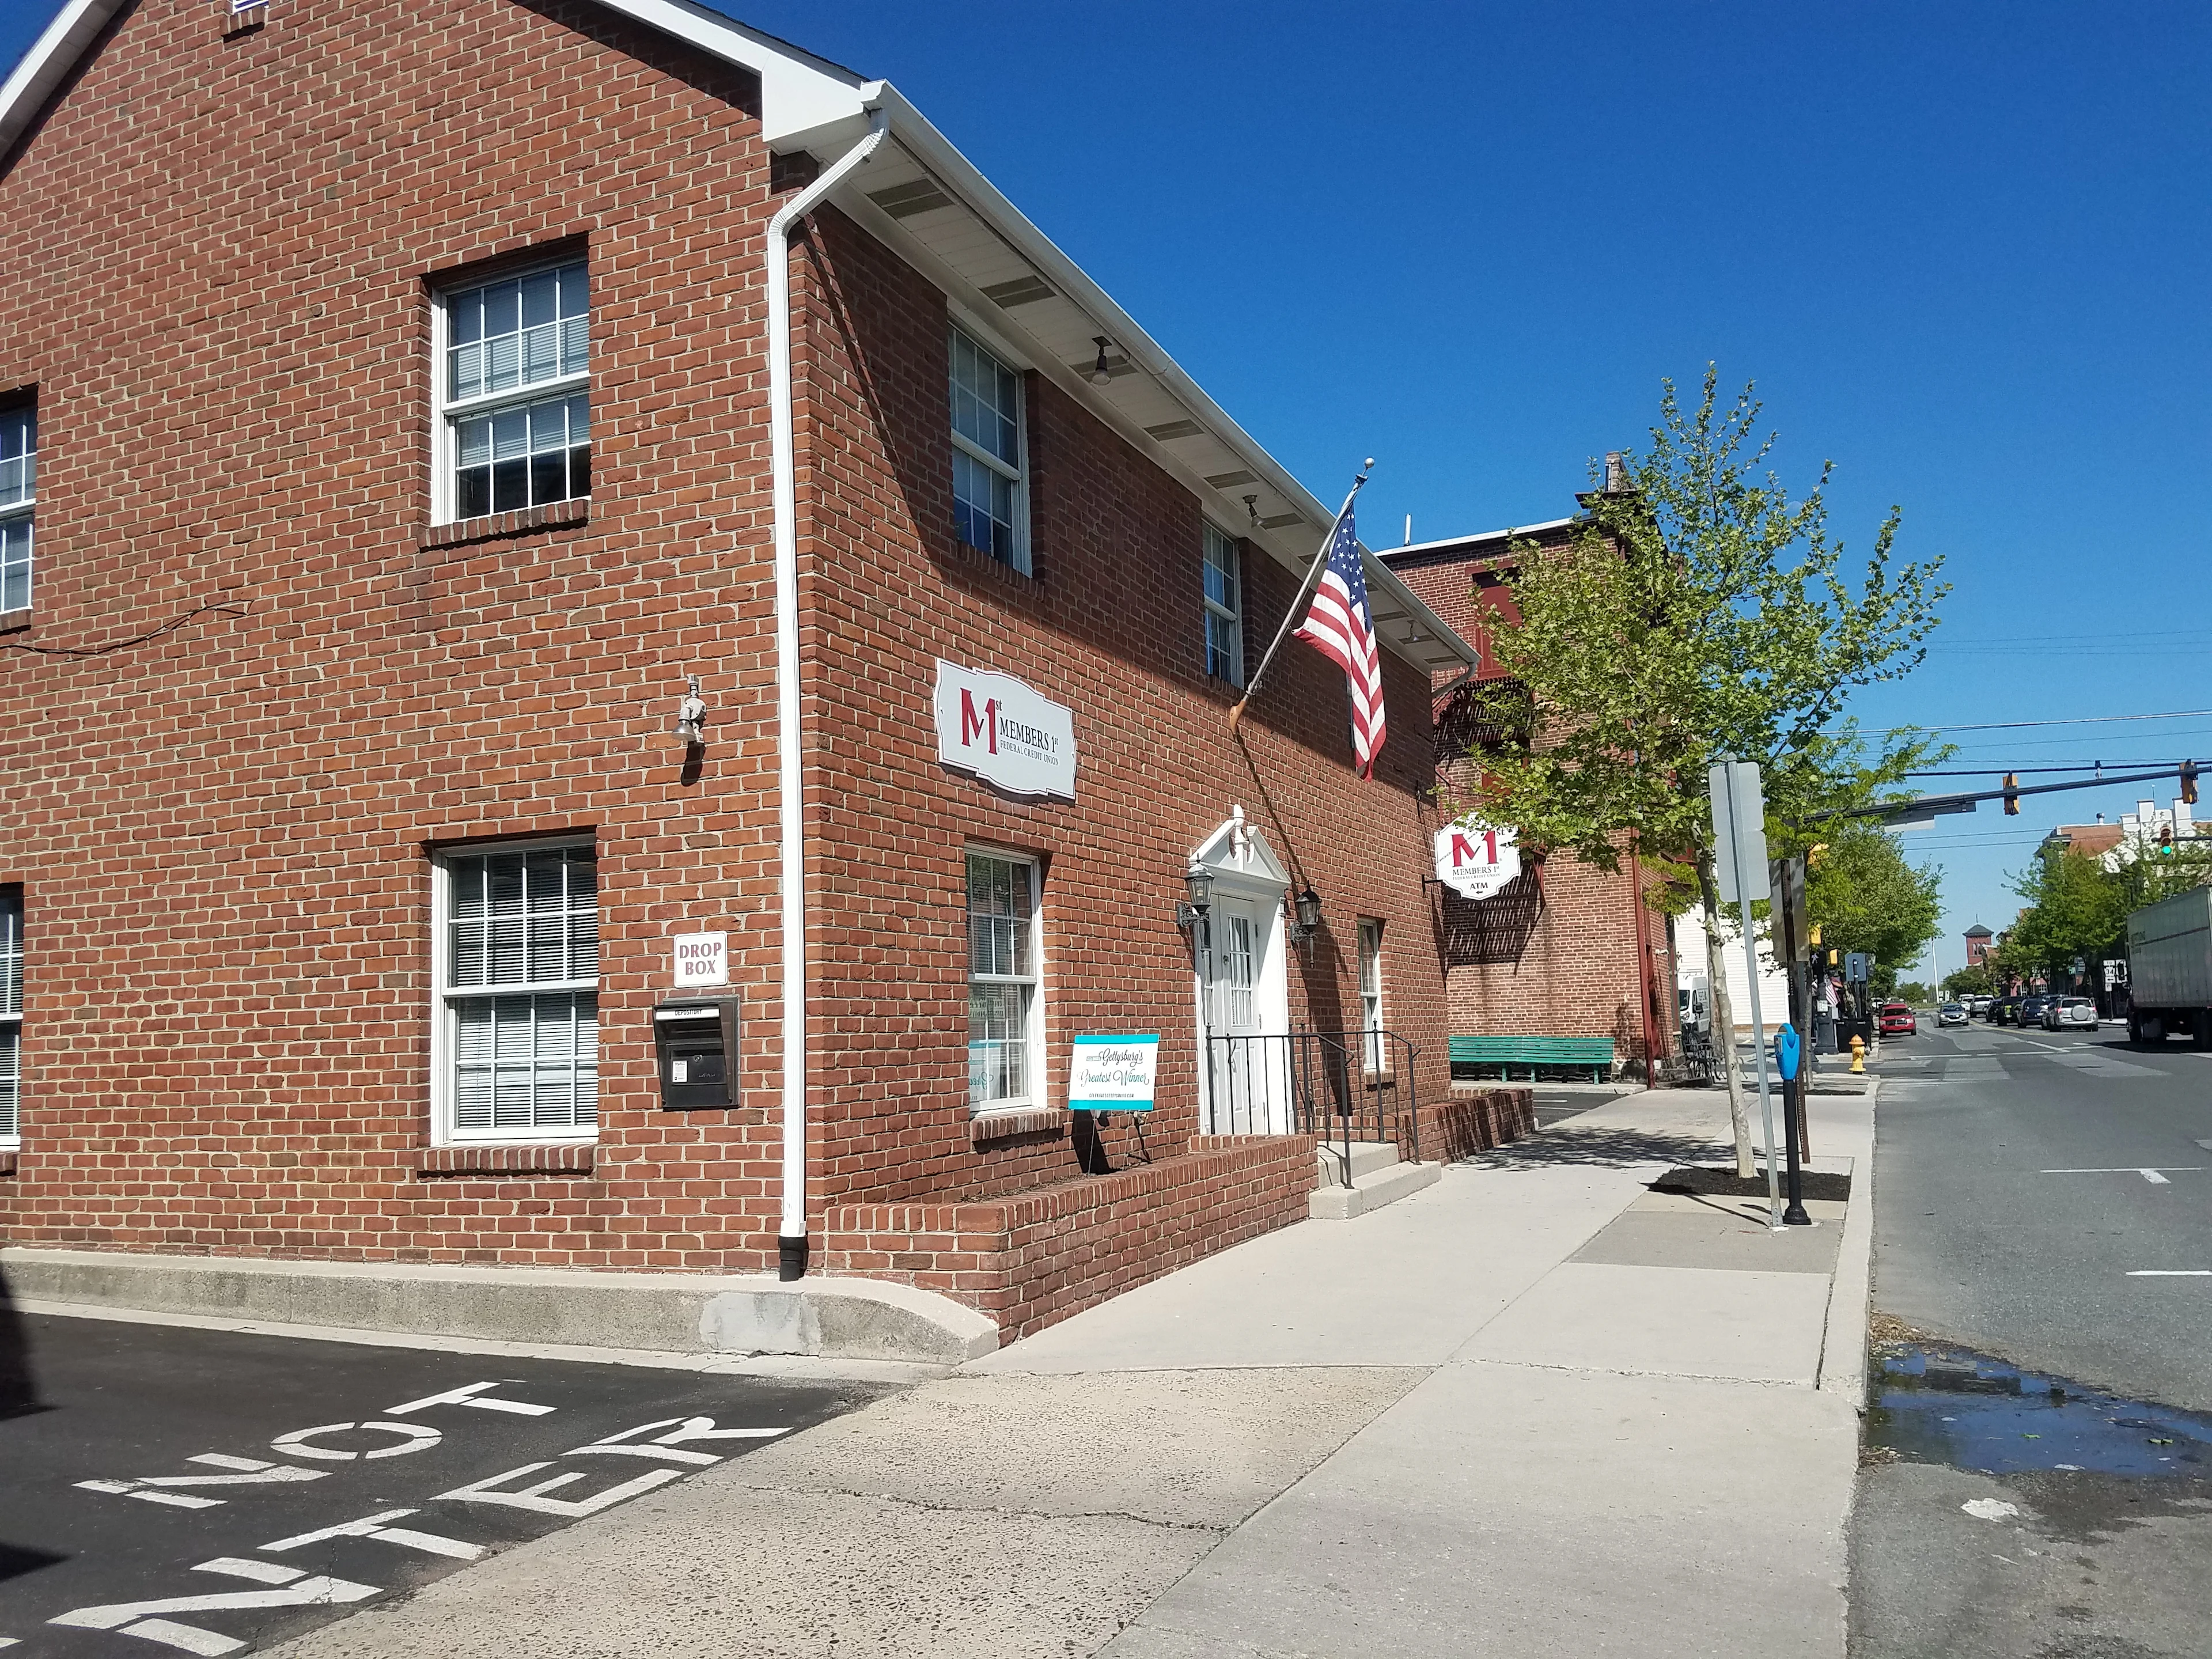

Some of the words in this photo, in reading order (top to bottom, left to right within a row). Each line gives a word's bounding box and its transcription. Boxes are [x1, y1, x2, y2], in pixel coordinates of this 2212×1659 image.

[1000, 717, 1049, 751] MEMBERS
[1000, 740, 1024, 755] FEDERAL
[1024, 748, 1043, 761] CREDIT
[1044, 754, 1059, 766] UNION
[1453, 866, 1491, 876] MEMBERS
[1470, 882, 1488, 890] ATM
[680, 942, 722, 959] DROP
[685, 960, 715, 975] BOX
[1103, 1048, 1143, 1067] Gettysburg's
[1077, 1069, 1111, 1087] Greatest
[1113, 1069, 1150, 1086] Winner
[71, 1380, 556, 1509] NOT
[0, 1415, 793, 1659] NTER
